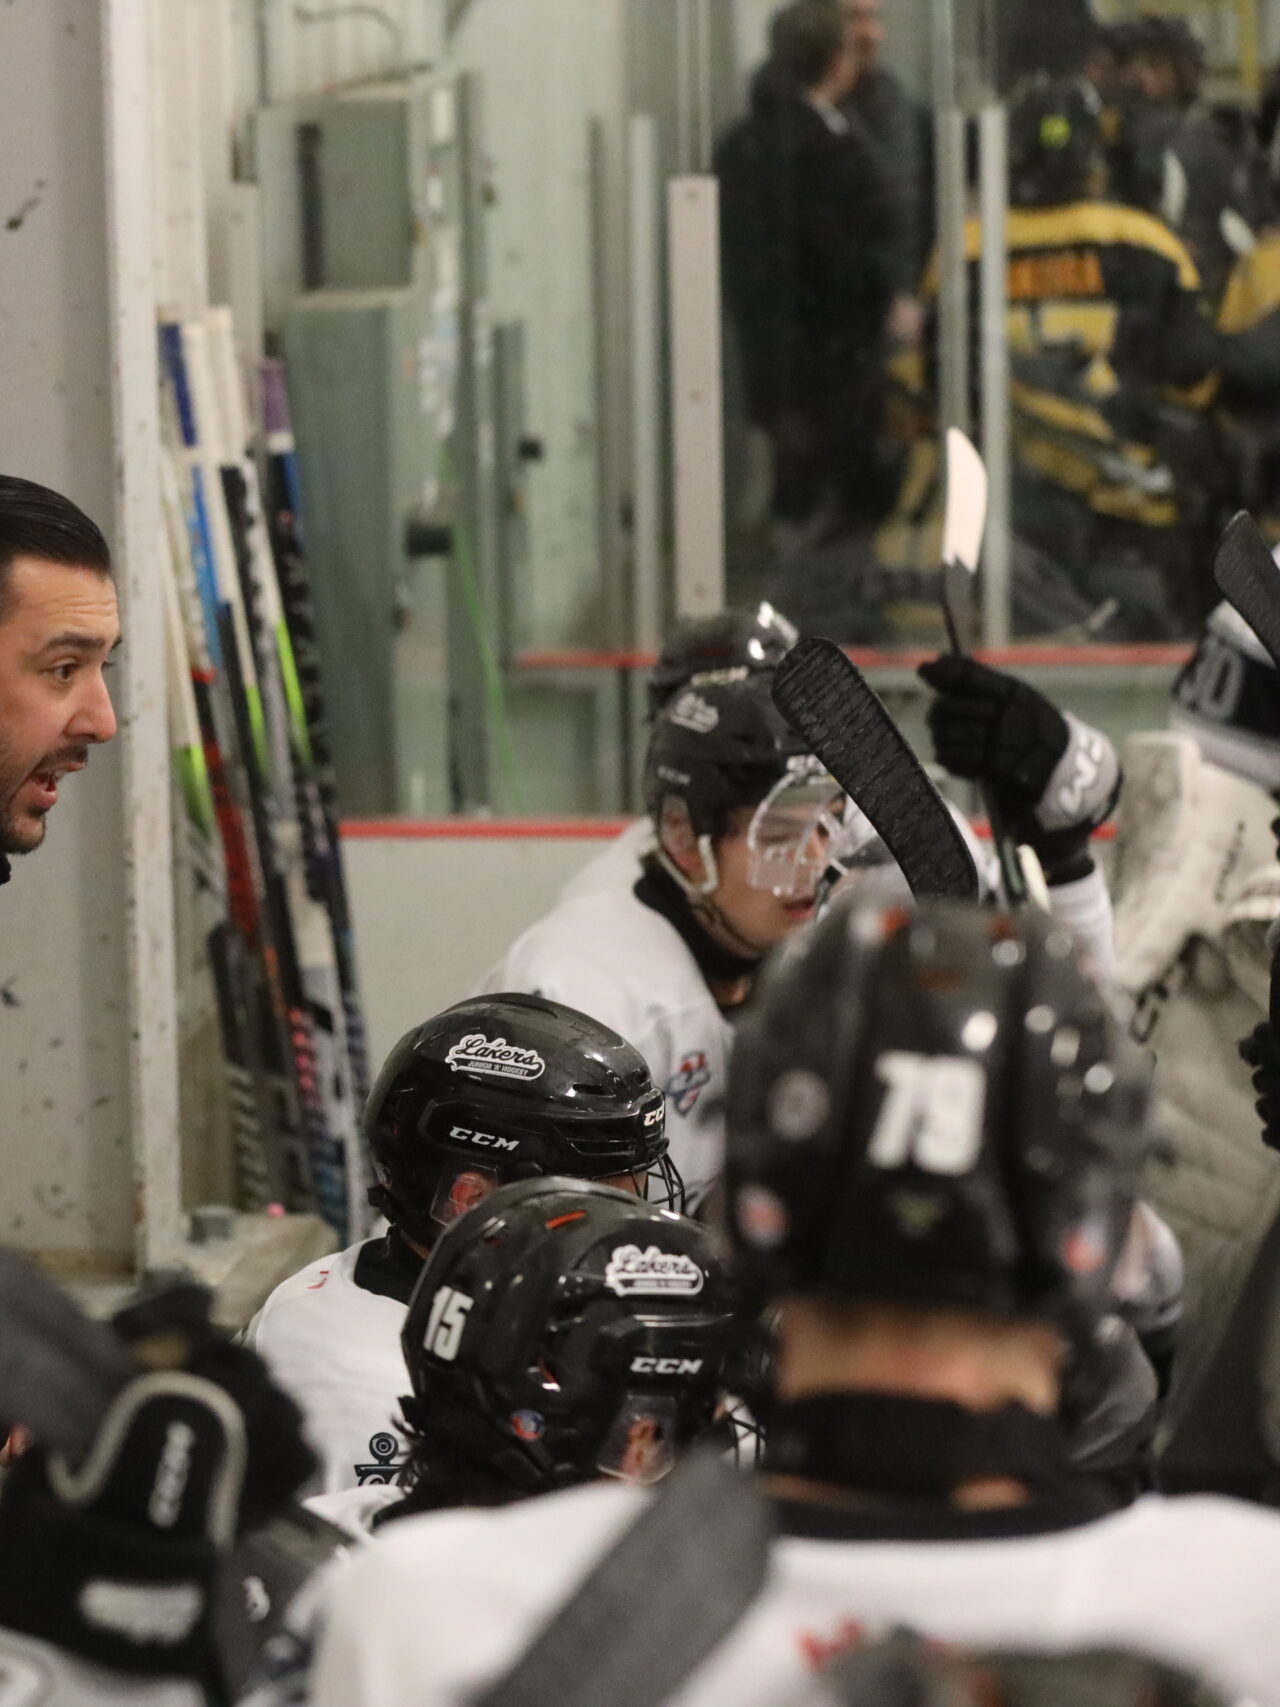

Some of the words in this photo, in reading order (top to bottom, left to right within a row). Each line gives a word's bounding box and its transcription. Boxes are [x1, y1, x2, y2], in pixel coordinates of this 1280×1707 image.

[455, 1038, 538, 1065] Lakers
[449, 1126, 521, 1152] CCM
[423, 1285, 474, 1361] 15
[630, 1357, 703, 1375] CCM
